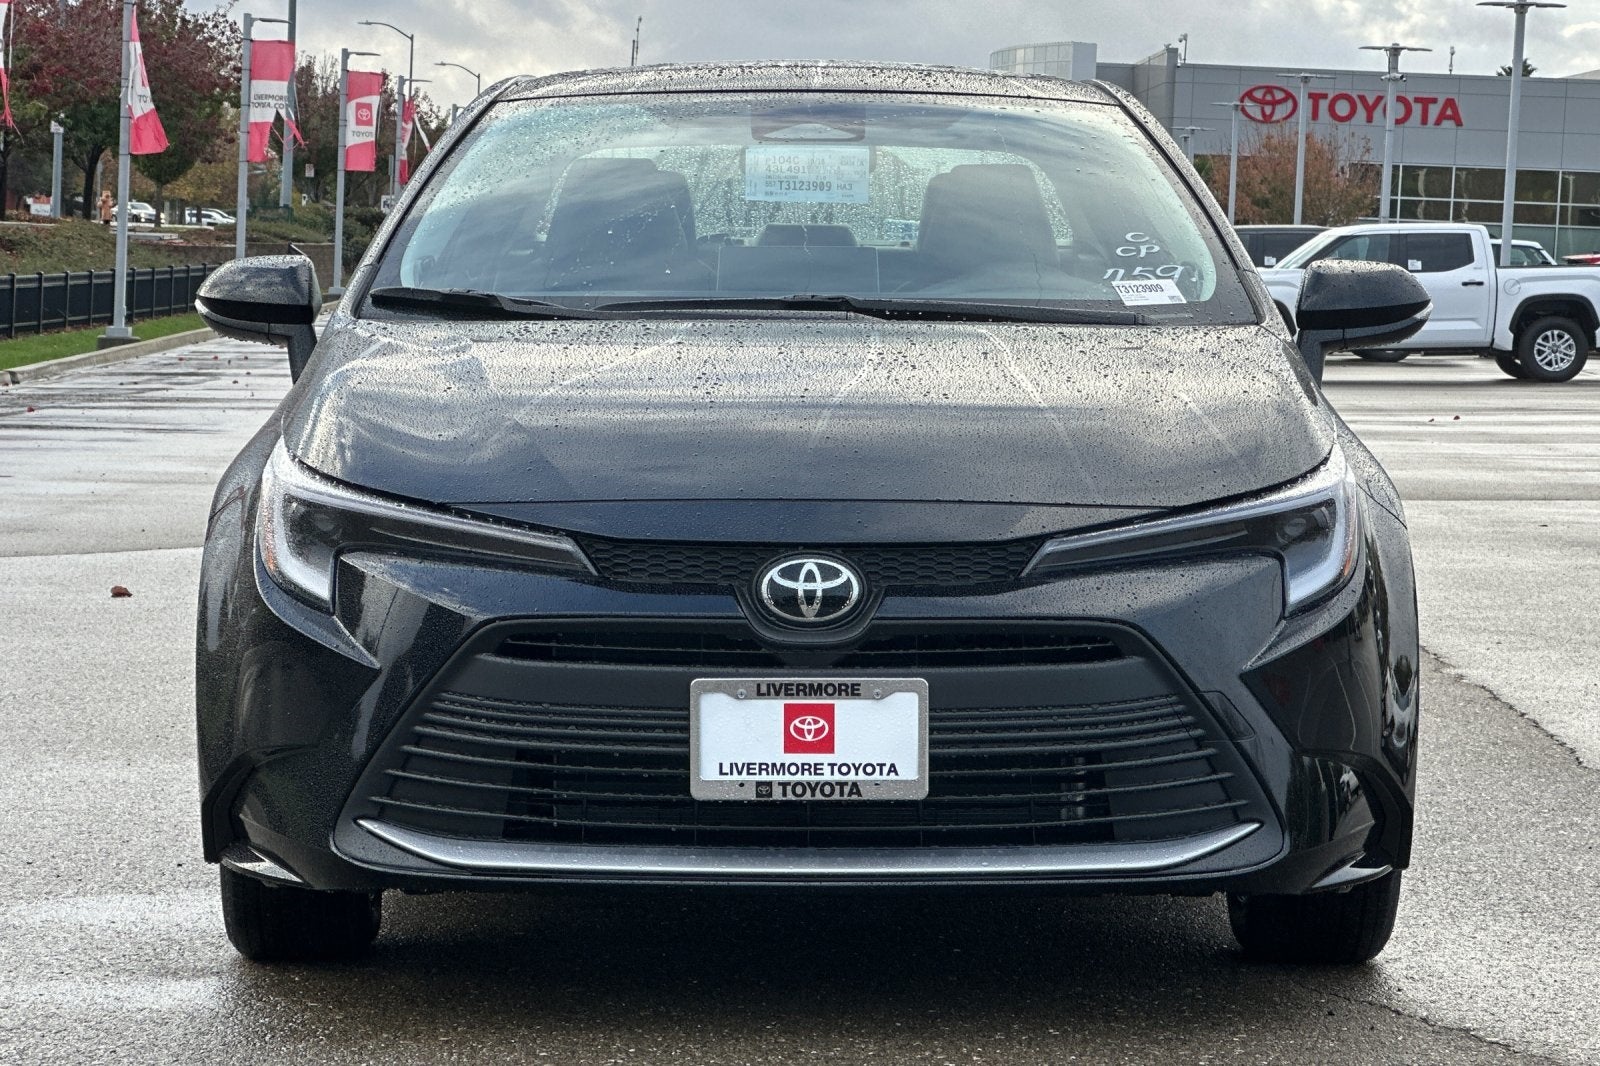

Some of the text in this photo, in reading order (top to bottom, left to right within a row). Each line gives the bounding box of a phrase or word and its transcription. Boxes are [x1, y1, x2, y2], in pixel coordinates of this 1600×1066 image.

[1307, 91, 1463, 127] TOYOTA
[352, 130, 374, 138] TOYOT
[778, 180, 832, 192] T3123909
[1115, 283, 1164, 294] T3123909
[756, 683, 862, 697] LIVERMORE
[718, 762, 899, 776] LIVERMORE TOYOTA
[778, 781, 863, 798] TOYOTA
